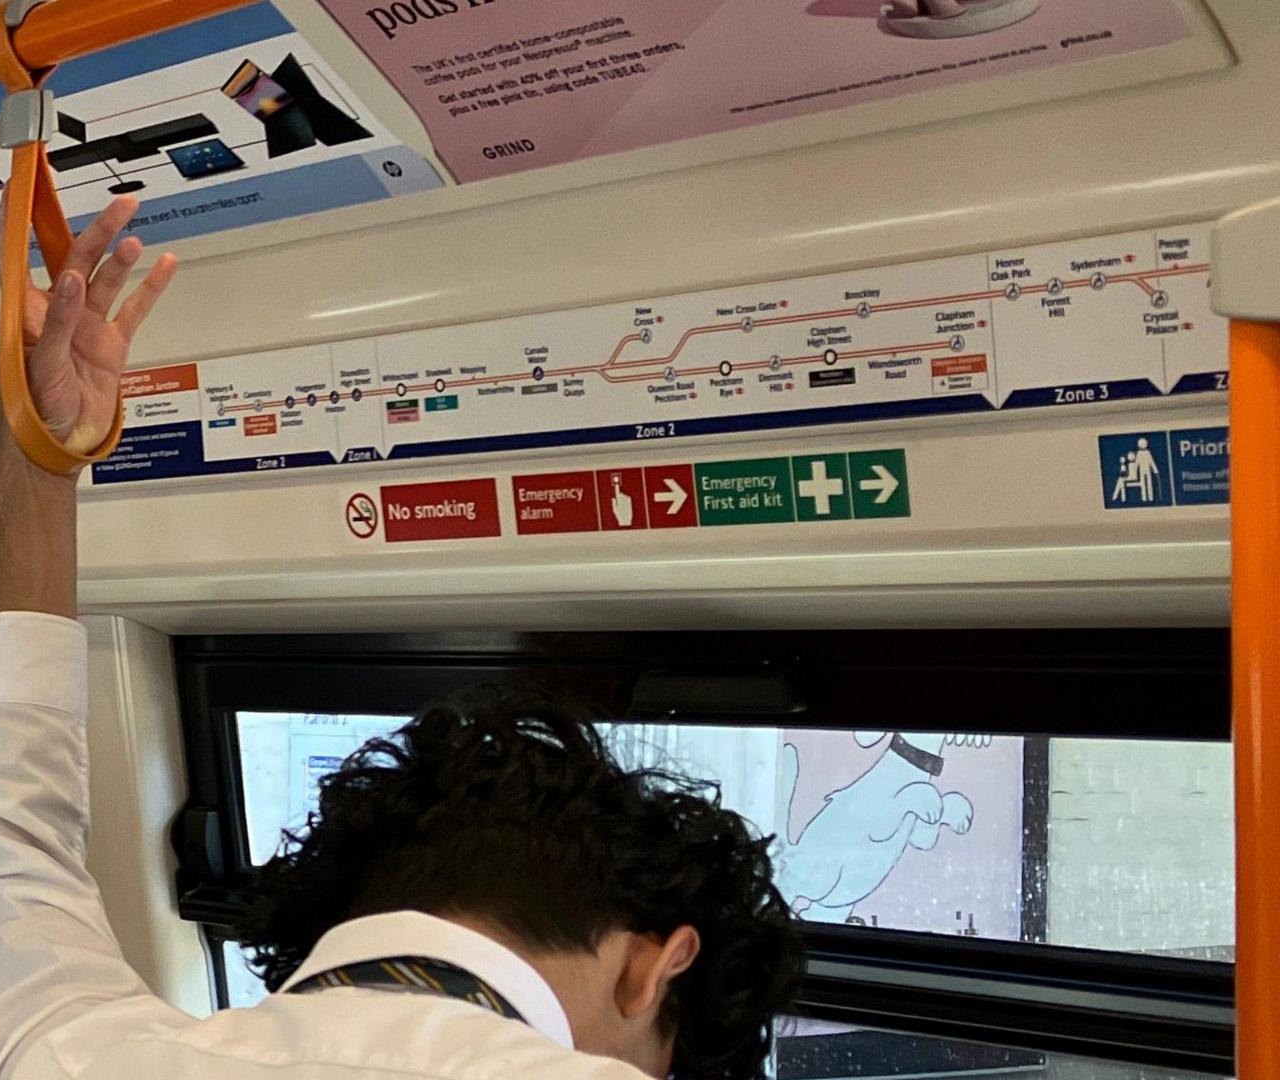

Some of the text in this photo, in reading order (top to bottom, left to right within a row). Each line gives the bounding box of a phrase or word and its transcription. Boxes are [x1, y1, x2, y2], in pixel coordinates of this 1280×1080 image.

[439, 93, 458, 104] Get
[459, 83, 495, 99] started
[561, 64, 584, 77] your
[609, 51, 641, 64] three
[573, 75, 600, 88] code
[482, 139, 536, 161] GRIND
[1158, 238, 1190, 250] Penge
[1161, 249, 1189, 261] West
[995, 257, 1025, 269] Honor
[1071, 256, 1122, 272] Sydenham
[991, 268, 1032, 282] Oak Park
[1041, 296, 1071, 308] Forest
[635, 308, 652, 316] New
[716, 302, 778, 317] New Cross Gate
[1049, 307, 1065, 318] Hill
[634, 318, 655, 327] Cross
[935, 310, 975, 323] Clapham
[1143, 311, 1179, 324] Crystal
[810, 326, 848, 338] Clapham
[936, 322, 975, 334] Junction
[1145, 324, 1179, 335] Palace
[1055, 384, 1109, 404] Zone 3
[635, 422, 676, 439] Zone 2
[348, 450, 373, 463] Zone
[256, 458, 279, 470] Zone
[702, 475, 777, 493] Emergency
[518, 487, 584, 504] Emergency
[703, 491, 784, 511] First aid kit
[388, 500, 476, 521] No smoking
[520, 506, 554, 521] alarm
